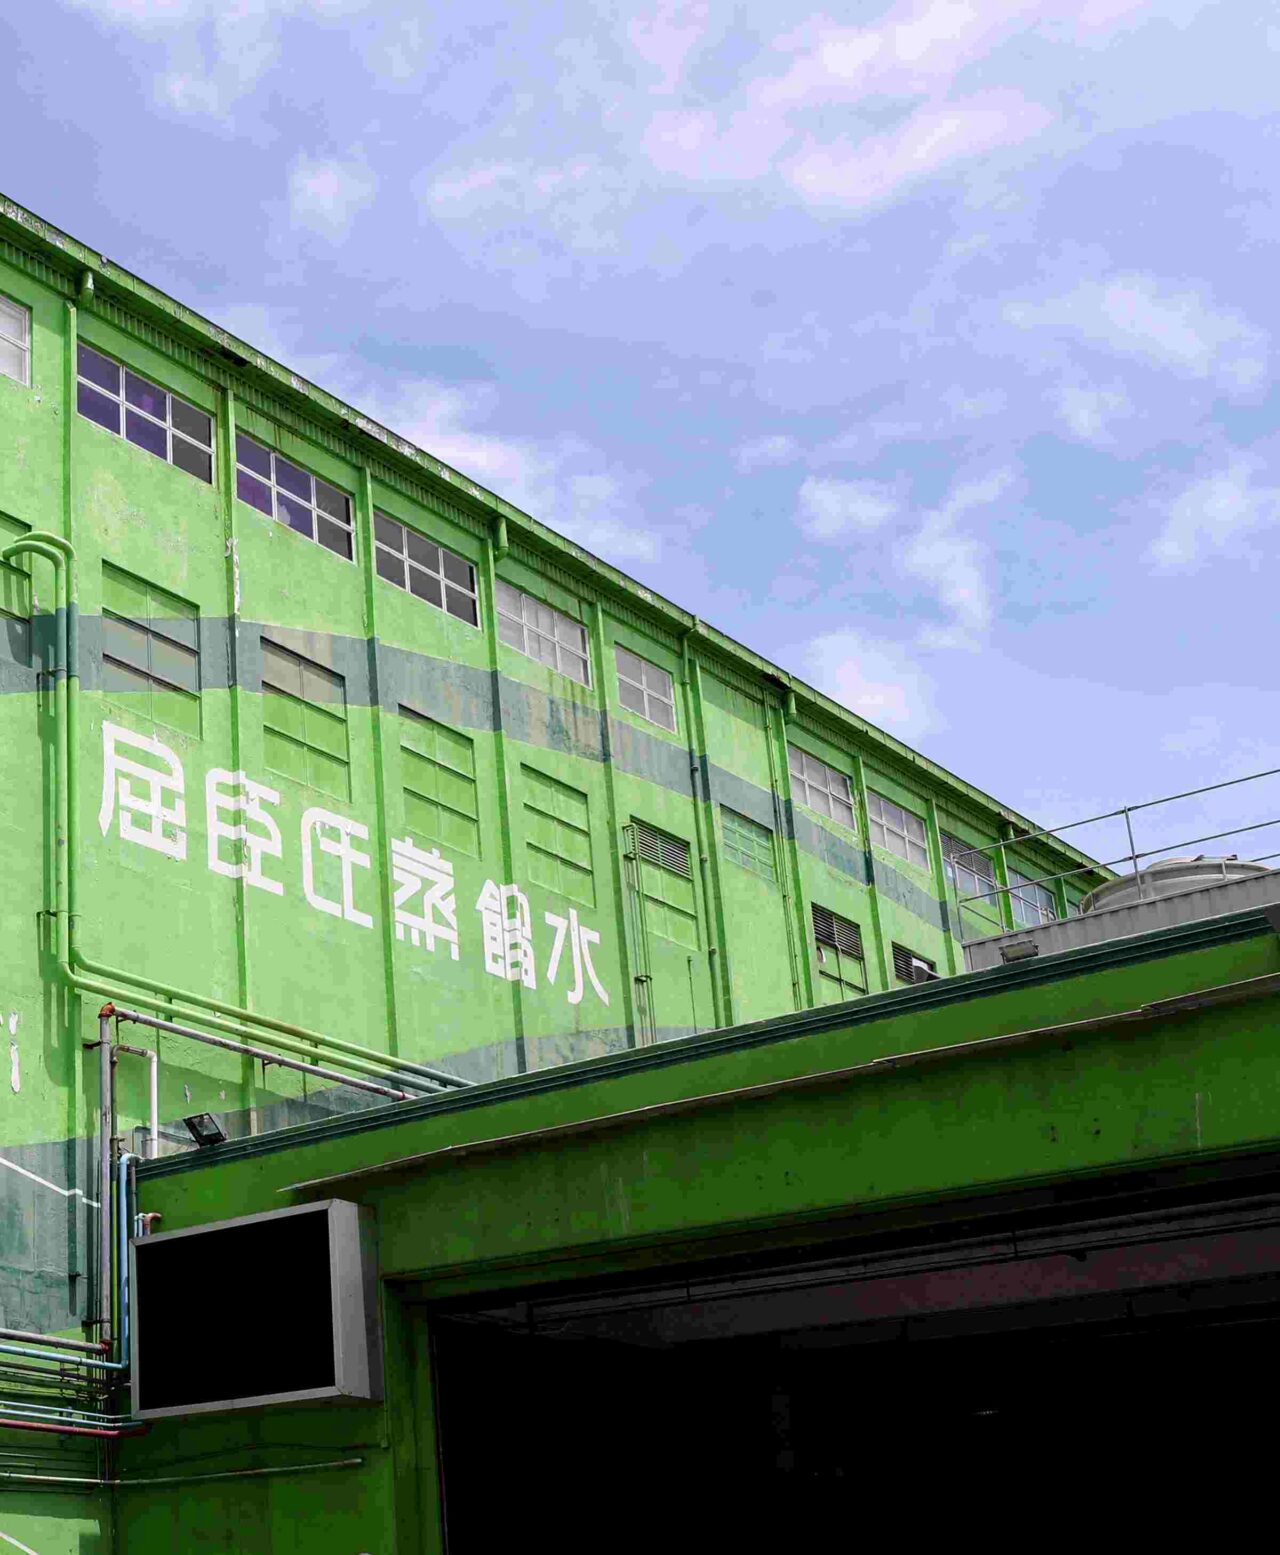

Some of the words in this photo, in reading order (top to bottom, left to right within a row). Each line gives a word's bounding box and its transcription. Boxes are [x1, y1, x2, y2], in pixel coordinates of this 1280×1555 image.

[98, 720, 609, 1007] 屈臣氏蒸餾水
